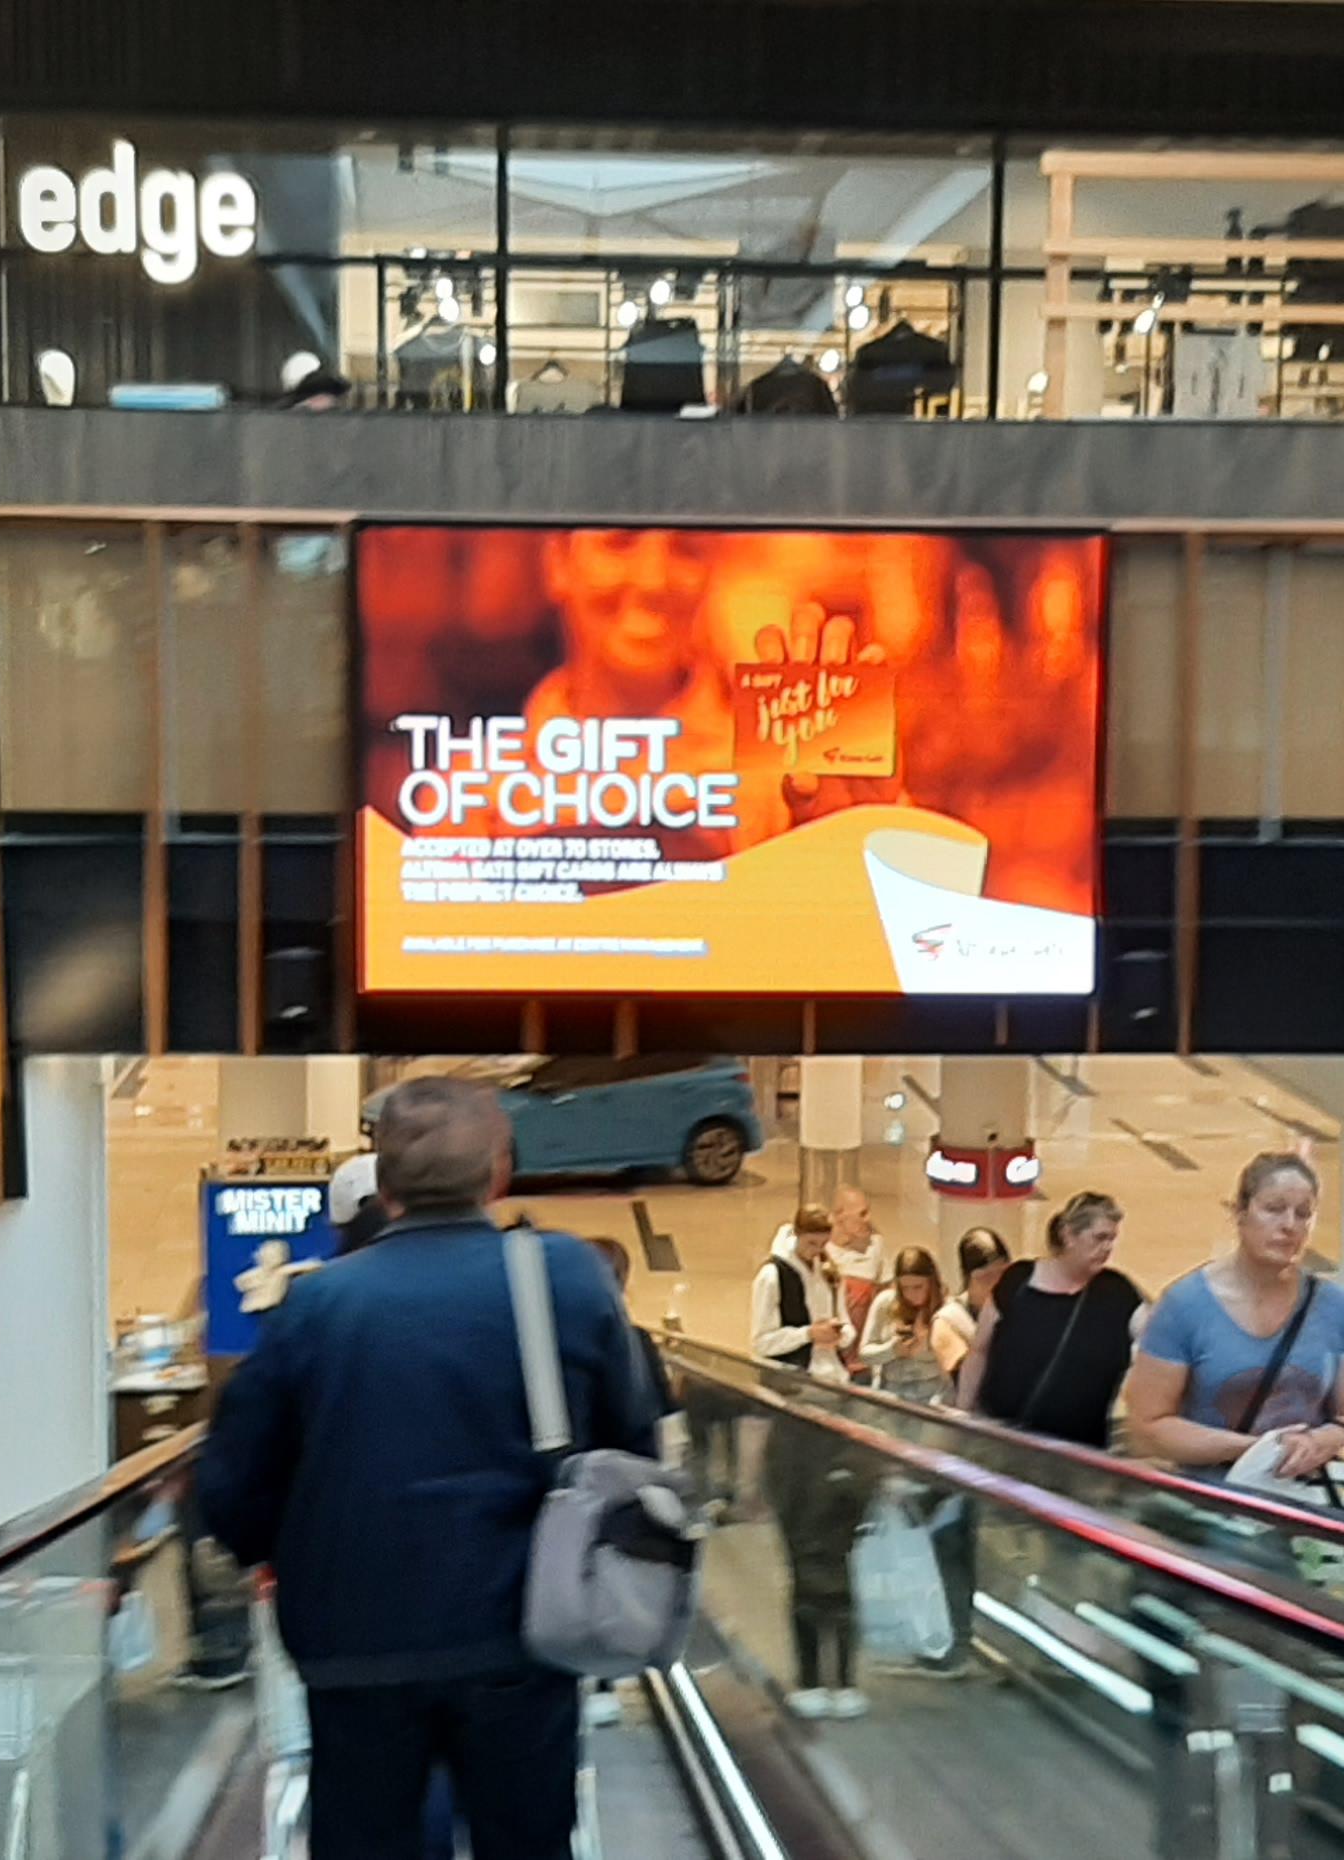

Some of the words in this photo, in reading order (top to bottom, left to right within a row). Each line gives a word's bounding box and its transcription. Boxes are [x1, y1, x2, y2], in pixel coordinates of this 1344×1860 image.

[19, 138, 256, 284] edge
[396, 714, 527, 771] THE
[536, 717, 680, 773] GIFT
[398, 770, 490, 826] OF
[498, 771, 740, 828] CHOICE
[219, 1187, 322, 1214] MISTER
[230, 1209, 309, 1234] MINIT
